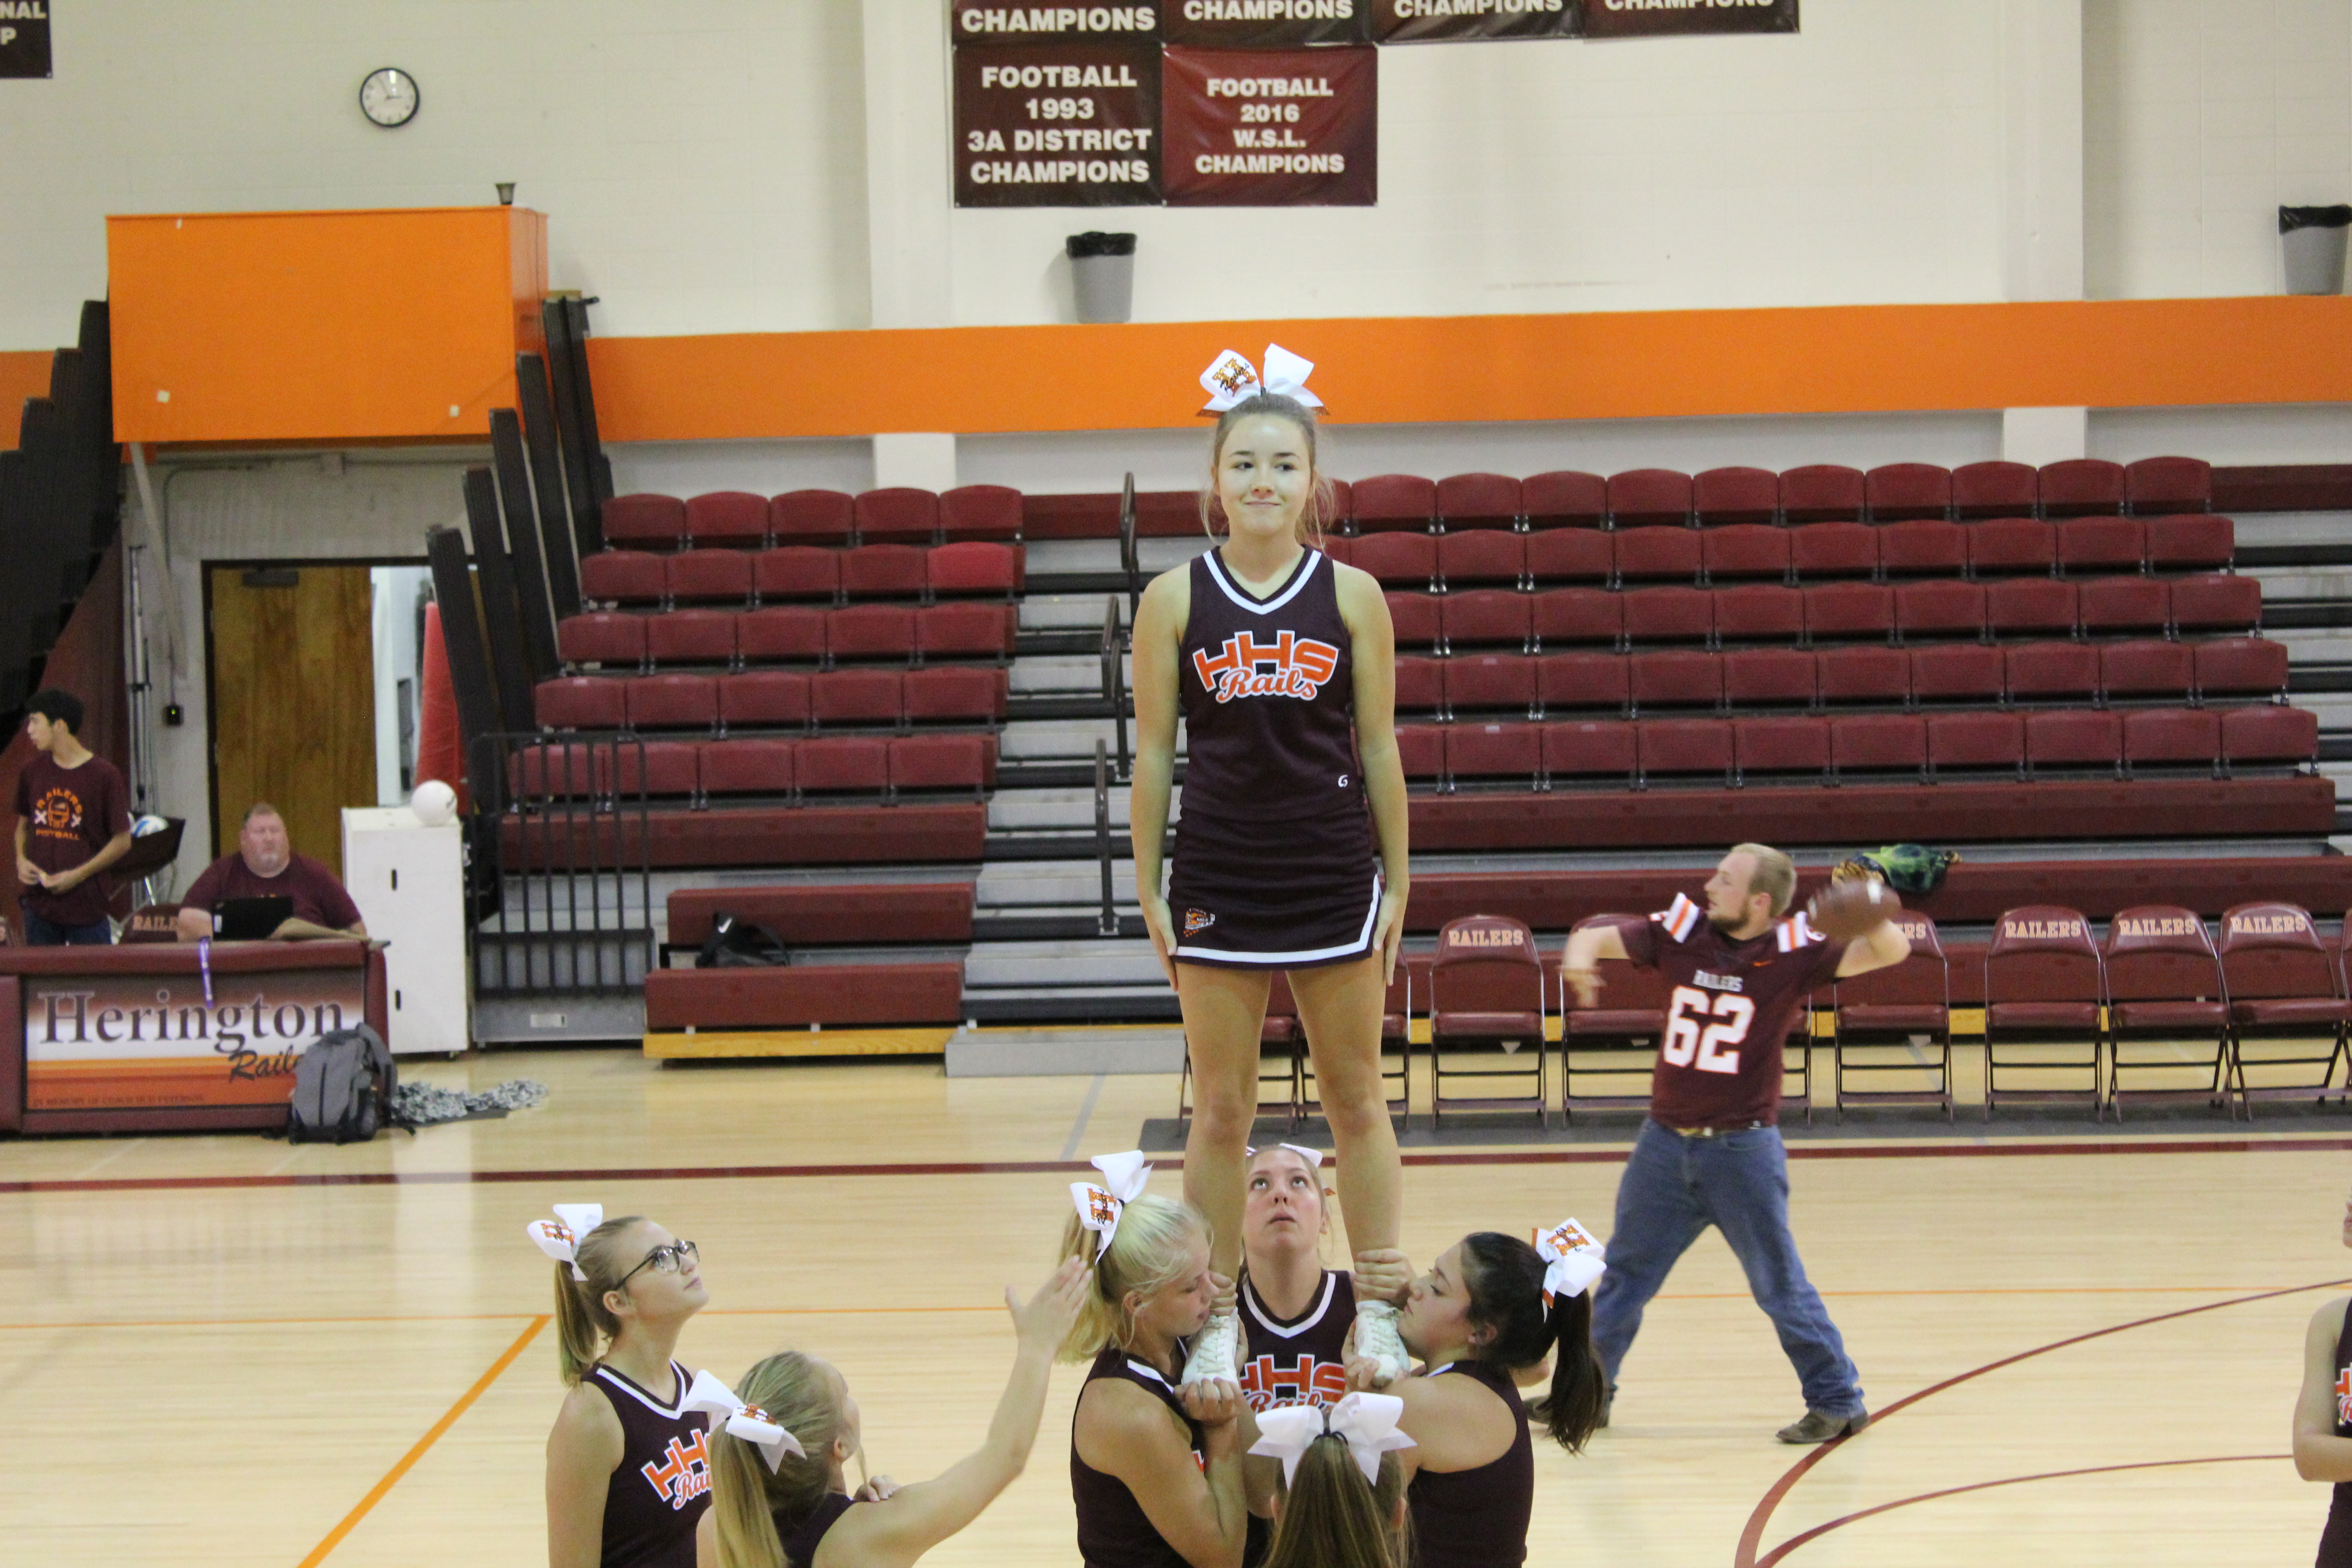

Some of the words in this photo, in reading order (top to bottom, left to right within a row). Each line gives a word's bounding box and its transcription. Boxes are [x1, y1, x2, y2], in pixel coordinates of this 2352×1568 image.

[961, 7, 1156, 32] CHAMPIONS
[1183, 0, 1353, 20] CHAMPIONS
[1393, 0, 1563, 18] CHAMPIONS
[981, 65, 1137, 88] FOOTBALL
[1206, 78, 1334, 97] FOOTBALL
[1025, 97, 1094, 120] 1993
[1240, 103, 1300, 122] 2016
[967, 130, 1006, 152] 3A
[1014, 128, 1152, 151] DISTRICT
[1233, 128, 1307, 148] W.S.L.
[970, 160, 1150, 184] CHAMPIONS
[1195, 154, 1345, 174] CHAMPIONS
[1192, 629, 1339, 692] HHS
[1215, 666, 1317, 704] Rails
[2004, 921, 2081, 938] RAILERS
[2118, 917, 2195, 936] RAILERS
[2230, 916, 2306, 934] RAILERS
[1448, 930, 1524, 946] RAILERS
[38, 990, 342, 1054] Herington
[1663, 985, 1756, 1074] 62
[640, 1428, 711, 1502] HH
